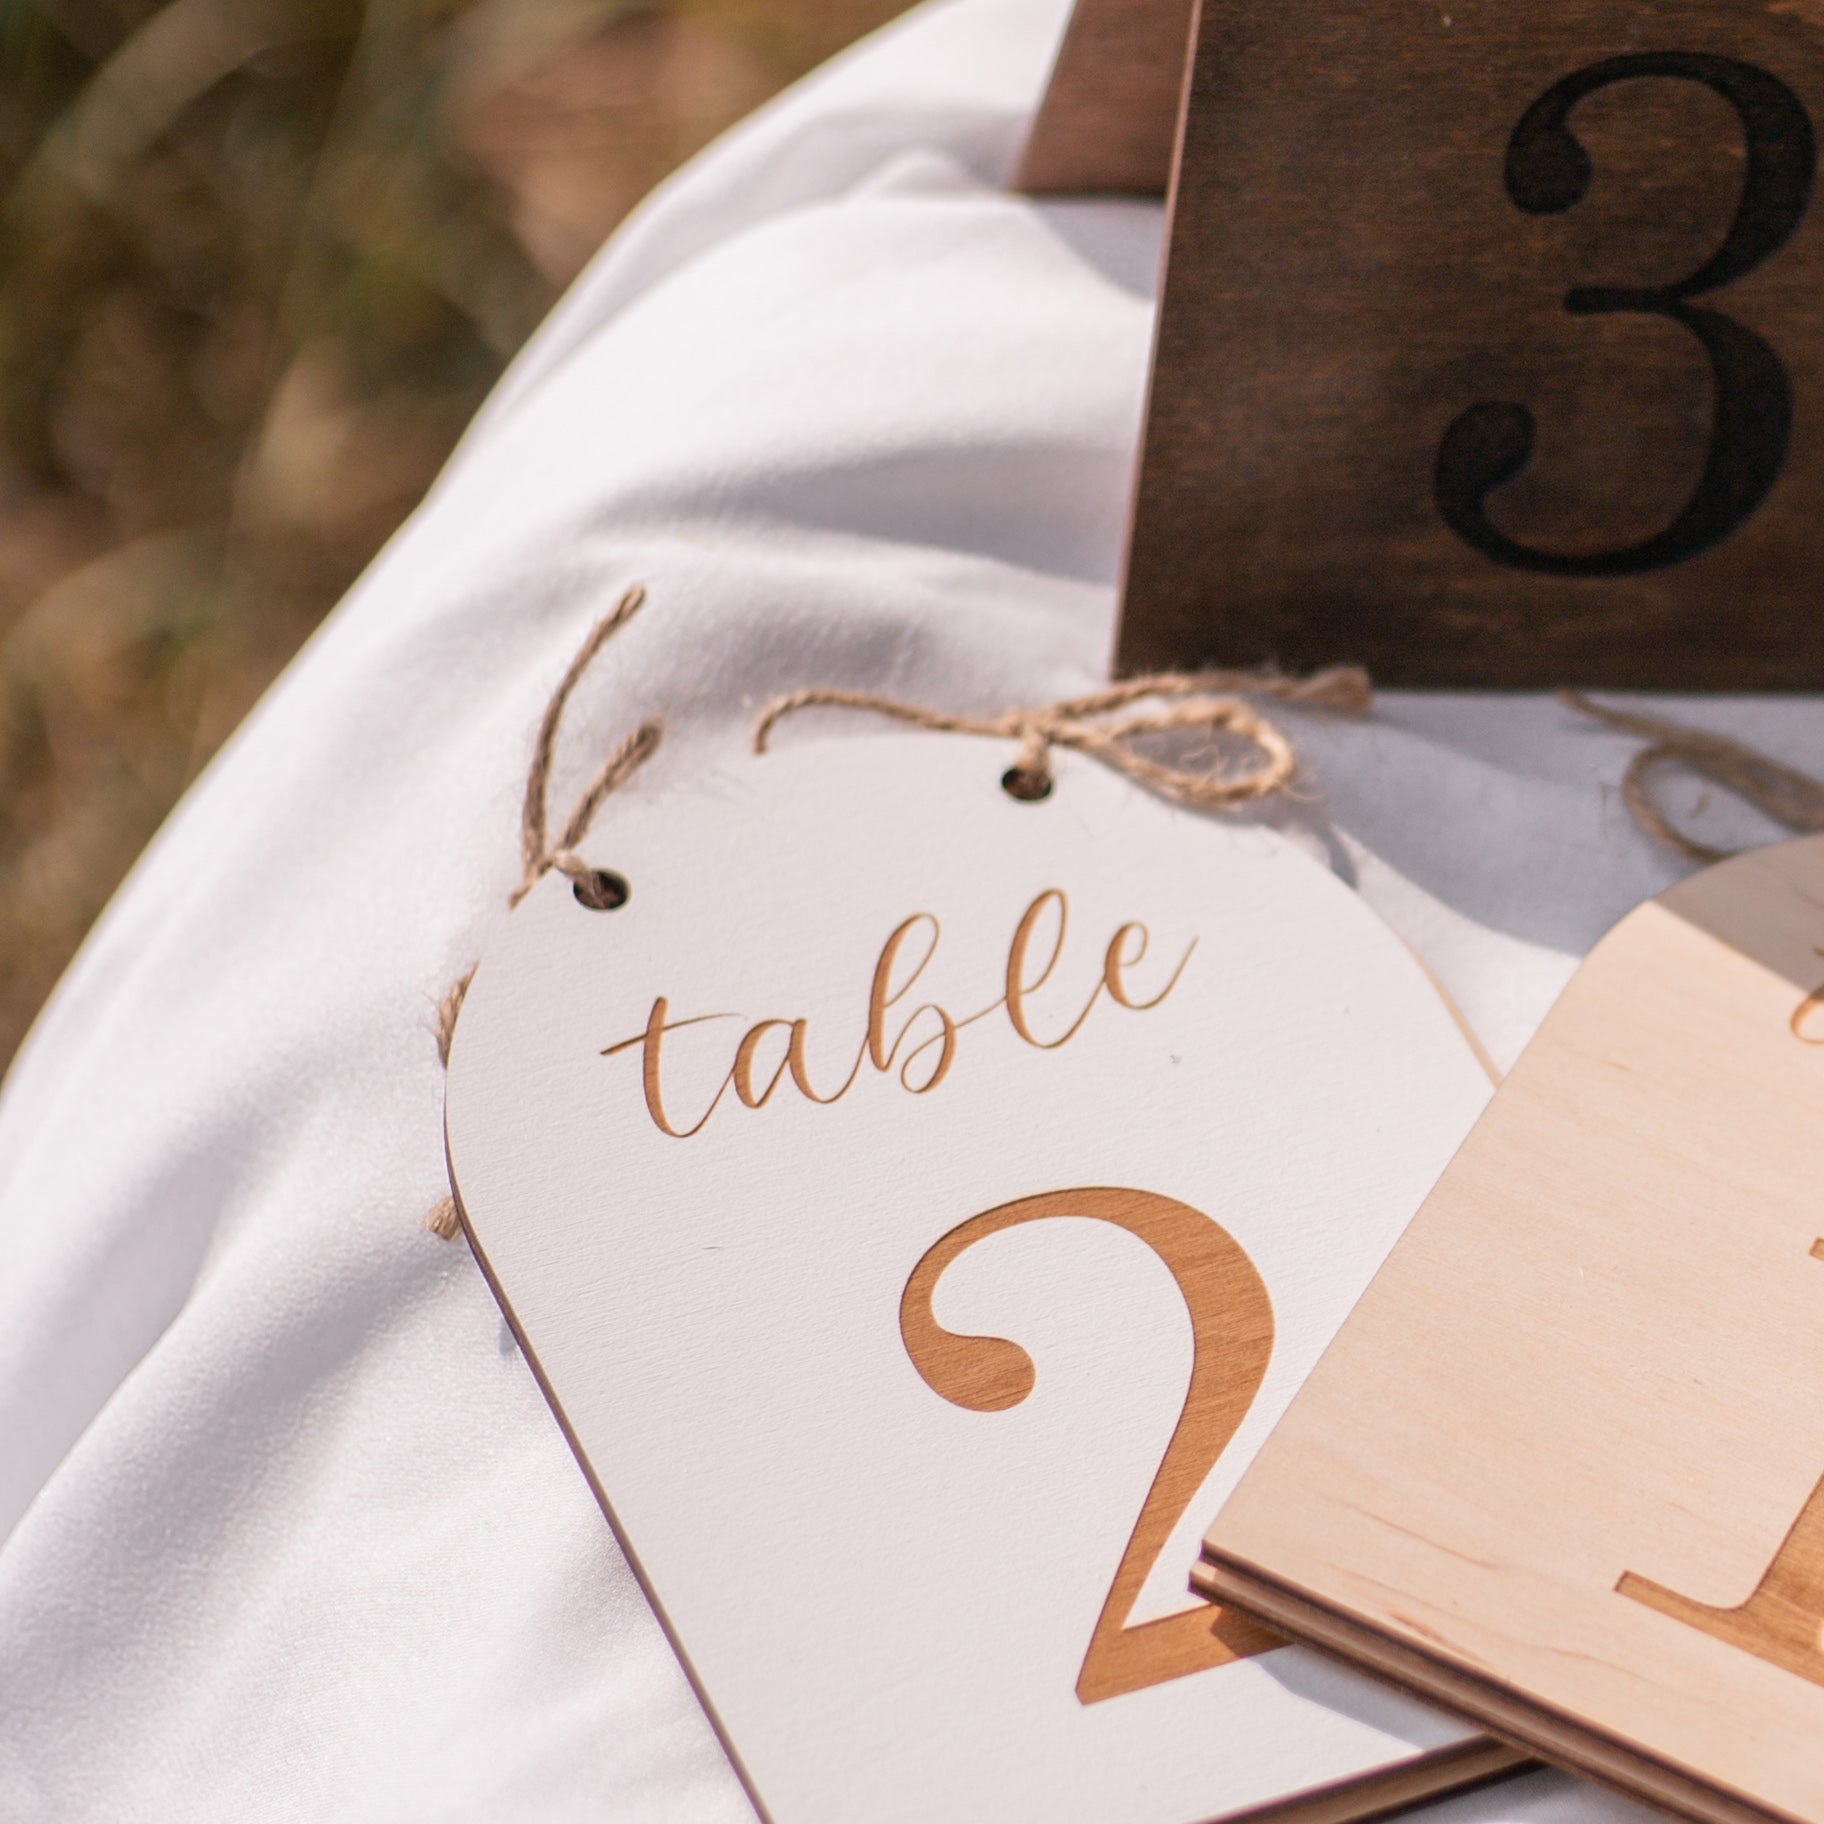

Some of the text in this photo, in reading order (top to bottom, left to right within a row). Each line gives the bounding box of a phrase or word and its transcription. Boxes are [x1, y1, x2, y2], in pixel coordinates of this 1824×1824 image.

[1433, 50, 1819, 576] 3
[600, 887, 1199, 1139] table
[898, 1184, 1297, 1706] 2
